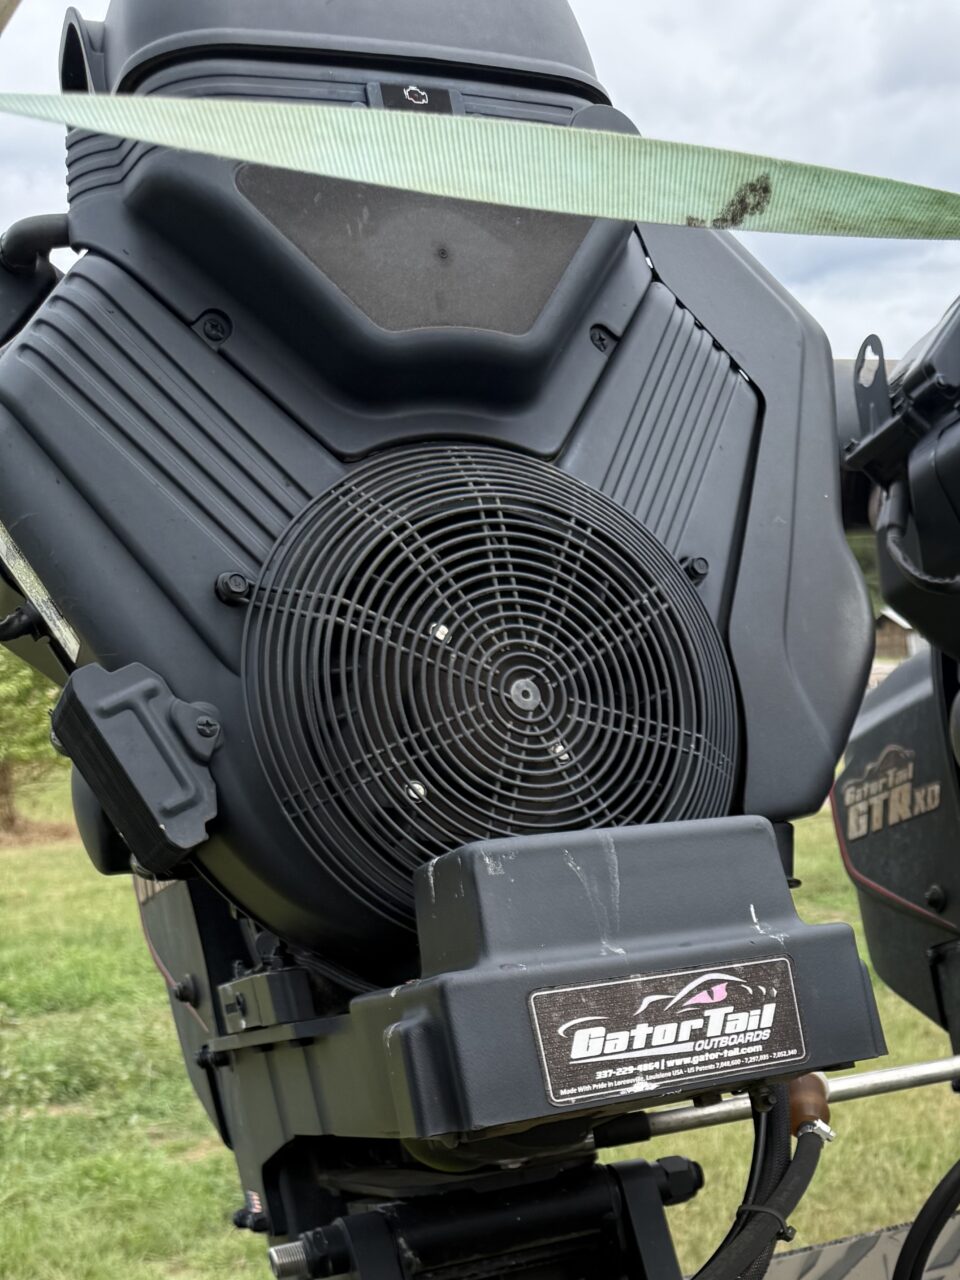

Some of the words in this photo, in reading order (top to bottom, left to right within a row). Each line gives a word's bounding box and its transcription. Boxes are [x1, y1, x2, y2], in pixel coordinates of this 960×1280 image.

[570, 1003, 777, 1060] GatorTail
[694, 1029, 771, 1052] OUTBOARDS
[594, 1061, 660, 1080] 337-229-4864
[665, 1044, 763, 1067] www.gator-tail.com
[559, 1088, 578, 1096] Made
[577, 1084, 592, 1094] With
[592, 1081, 608, 1091] Pride
[608, 1079, 614, 1088] in
[672, 1068, 684, 1077] USA
[687, 1066, 695, 1074] US
